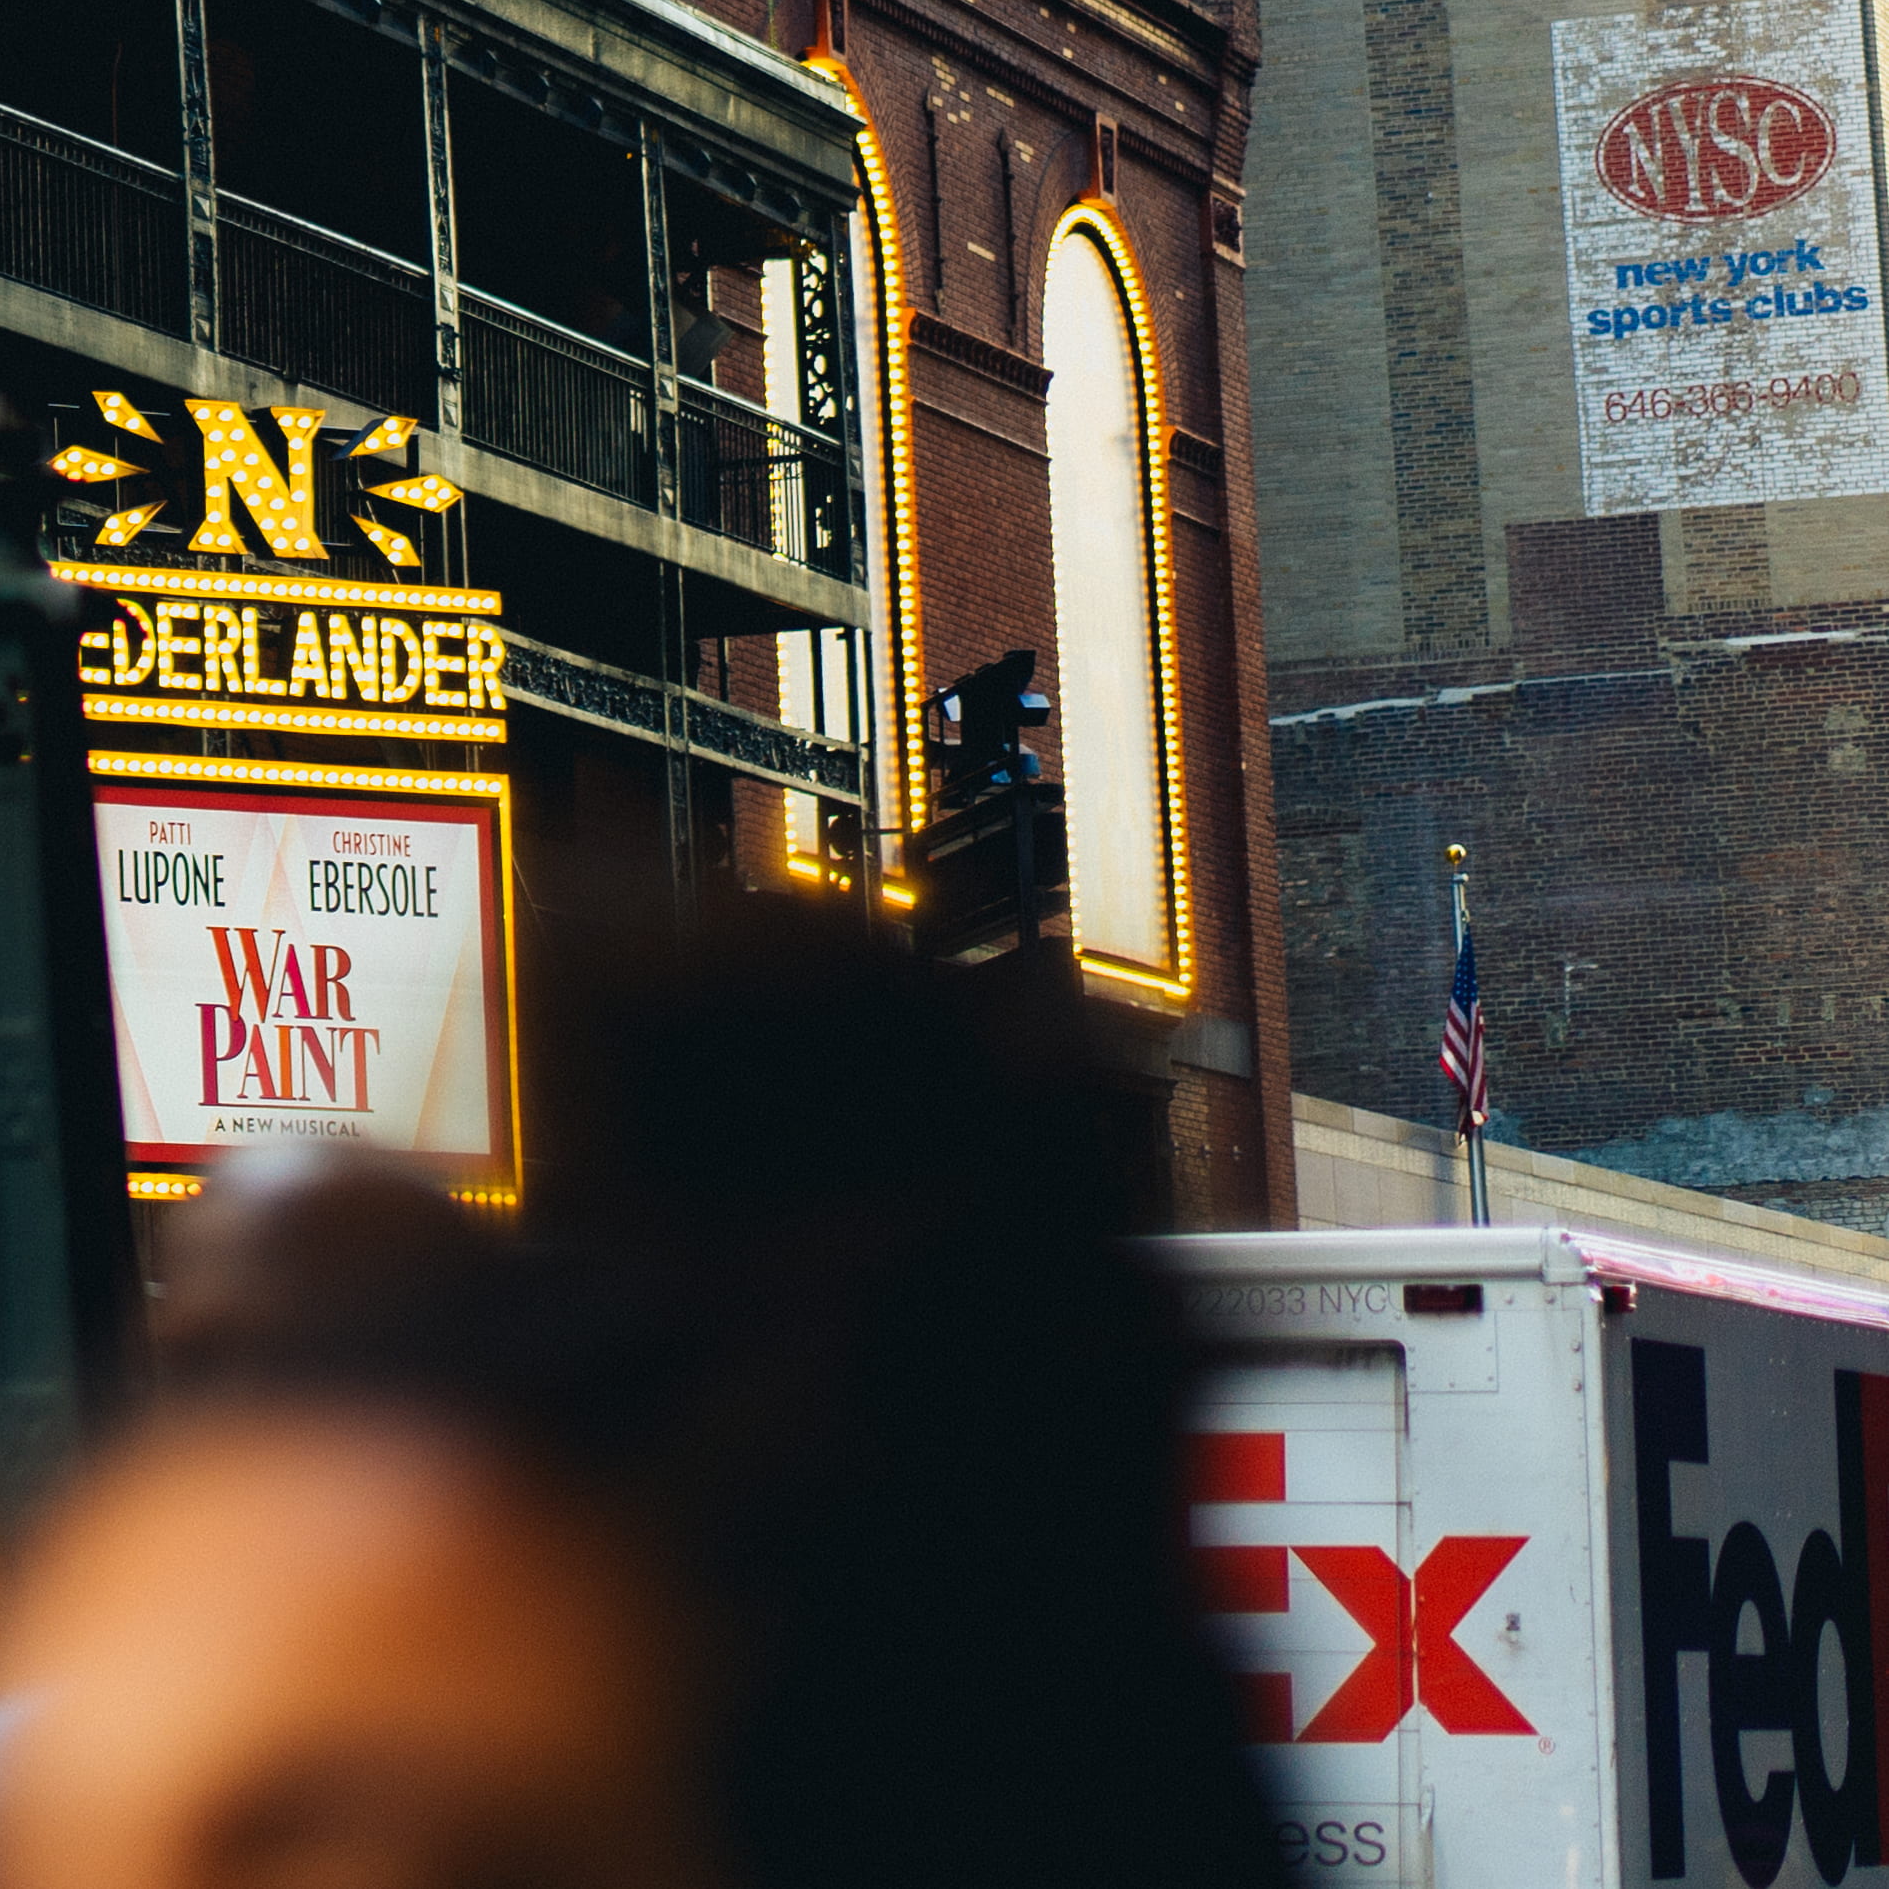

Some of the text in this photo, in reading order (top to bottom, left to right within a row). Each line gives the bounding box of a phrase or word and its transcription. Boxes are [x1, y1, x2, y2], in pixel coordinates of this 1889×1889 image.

[1623, 88, 1809, 212] NYSC
[1616, 239, 1825, 289] new york
[1587, 281, 1869, 340] sports clubs
[1605, 371, 1861, 423] 646-366-9400
[185, 399, 330, 560] N
[78, 598, 507, 710] EDERLANDER
[149, 821, 411, 858] PATTI CHRISTINE
[118, 849, 439, 918] LUPONE EBERSOLE
[205, 926, 356, 1023] WAR
[195, 1003, 380, 1113] PAINT
[215, 1118, 360, 1138] A NEW MUSICAL
[1631, 1338, 1889, 1889] Fed
[1276, 1820, 1387, 1866] ess
